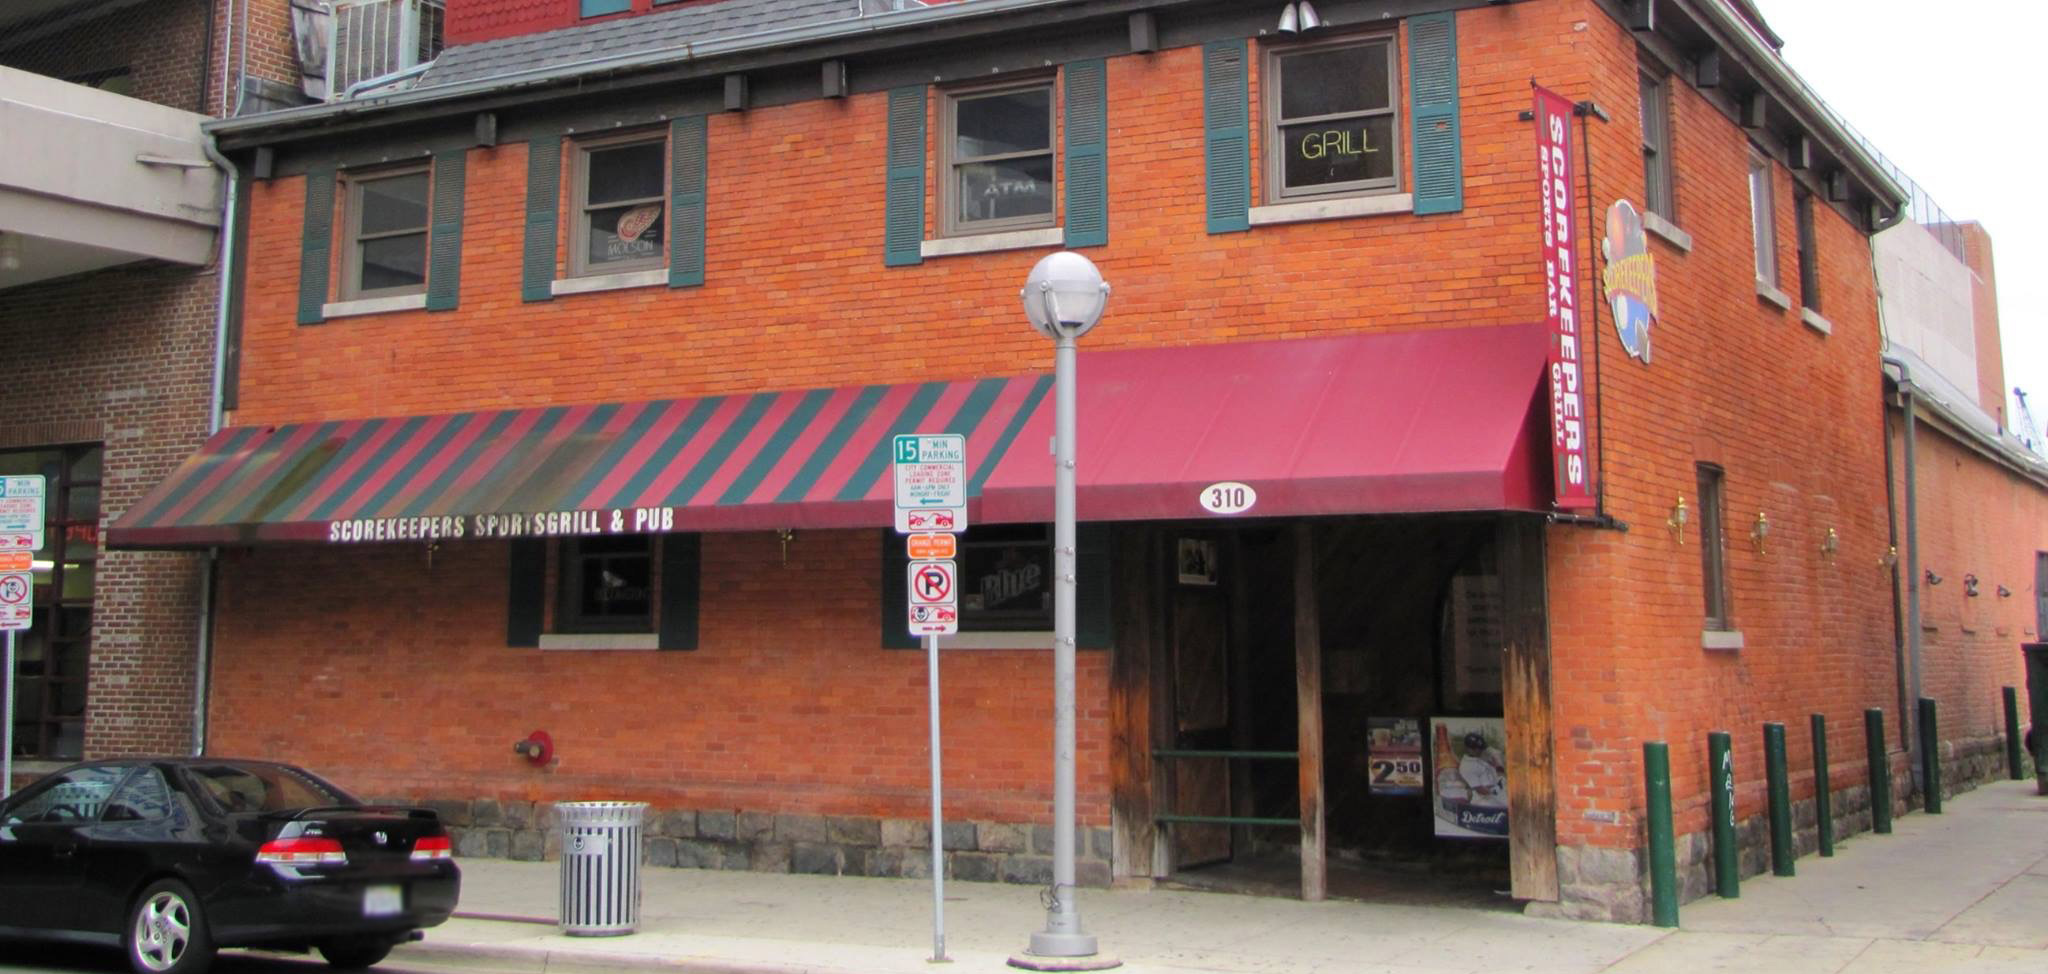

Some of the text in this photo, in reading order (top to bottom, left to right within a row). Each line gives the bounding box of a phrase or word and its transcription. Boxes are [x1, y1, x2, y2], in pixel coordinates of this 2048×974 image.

[1302, 128, 1379, 159] GRILL
[984, 180, 1036, 199] ATM
[608, 239, 654, 258] MOLSON
[1540, 145, 1564, 447] SPORTS BAR GRILL
[1551, 114, 1582, 484] SCOREKEEPERS
[897, 440, 948, 460] 15 MIN
[922, 450, 960, 460] PARKING
[8, 487, 40, 495] PARKING
[1212, 488, 1244, 508] 310
[330, 515, 465, 542] SCOREKEEPERS
[611, 508, 624, 532] &
[635, 506, 674, 531] PUB
[1461, 810, 1505, 824] Detroit
